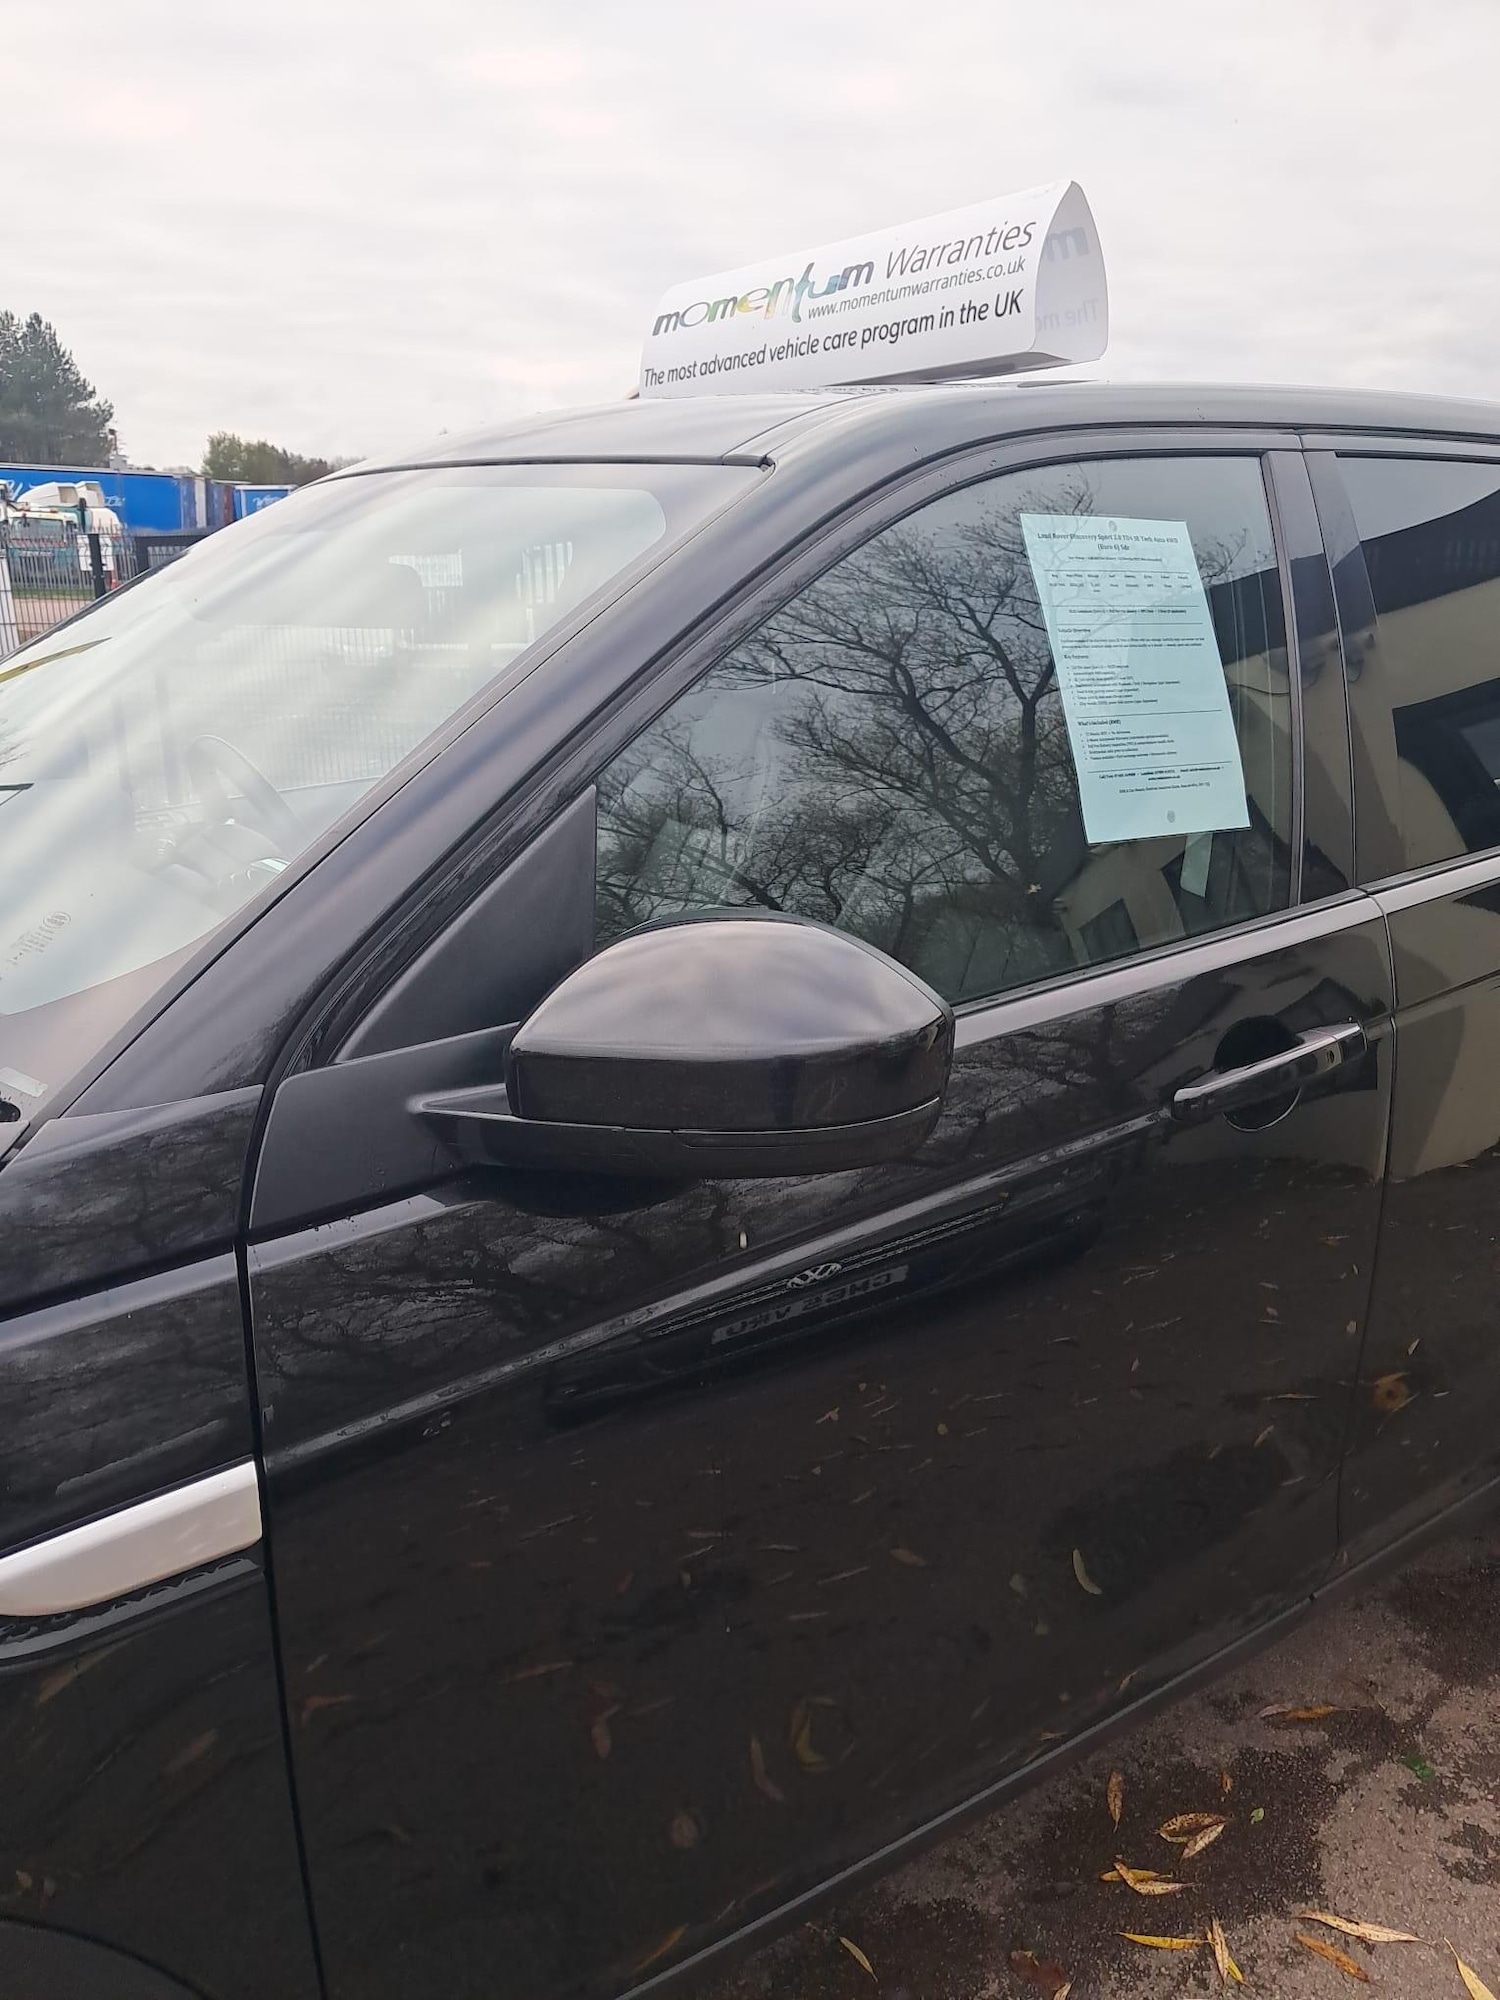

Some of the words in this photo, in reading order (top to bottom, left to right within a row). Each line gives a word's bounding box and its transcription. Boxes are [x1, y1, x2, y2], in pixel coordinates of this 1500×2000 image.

[652, 262, 875, 337] momentum
[885, 220, 1037, 280] Warranties
[808, 255, 1026, 320] www.momentumwarranties.co.uk
[644, 367, 665, 388] The
[667, 359, 697, 382] most
[699, 344, 766, 376] advanced
[770, 334, 819, 362] vehicle
[823, 329, 858, 352] care
[861, 312, 935, 349] program
[938, 305, 955, 329] in
[959, 300, 990, 325] the
[994, 288, 1025, 317] UK
